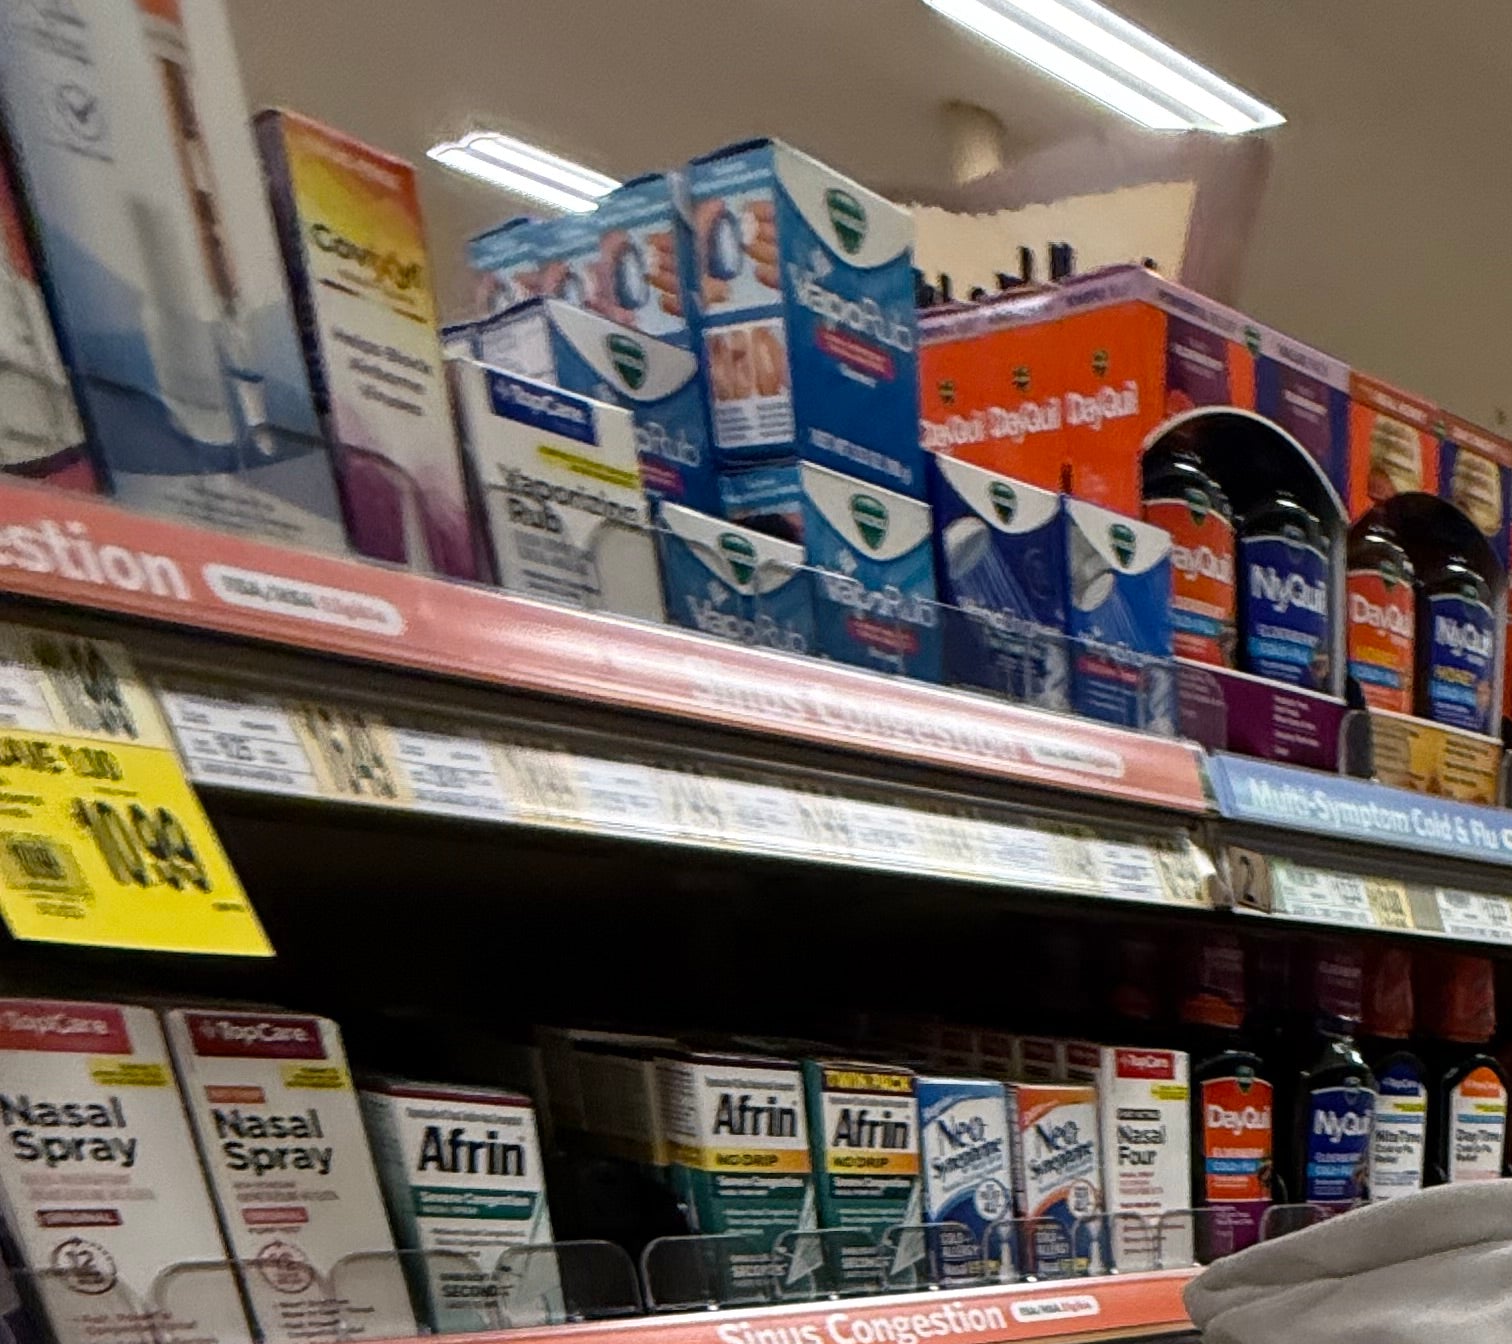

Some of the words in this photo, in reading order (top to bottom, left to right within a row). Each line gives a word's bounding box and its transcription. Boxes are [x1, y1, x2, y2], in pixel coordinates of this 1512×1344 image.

[1412, 808, 1454, 842] Cold
[1470, 820, 1501, 850] Flu
[1, 1092, 127, 1129] Nasal
[211, 1107, 325, 1139] Nasal
[713, 1092, 798, 1138] Afrin
[831, 1108, 910, 1150] Afrin
[8, 1129, 138, 1168] Spray
[416, 1124, 527, 1177] Afrin
[1116, 1125, 1167, 1146] Nasal
[221, 1141, 333, 1176] Spray
[1117, 1147, 1157, 1167] Four
